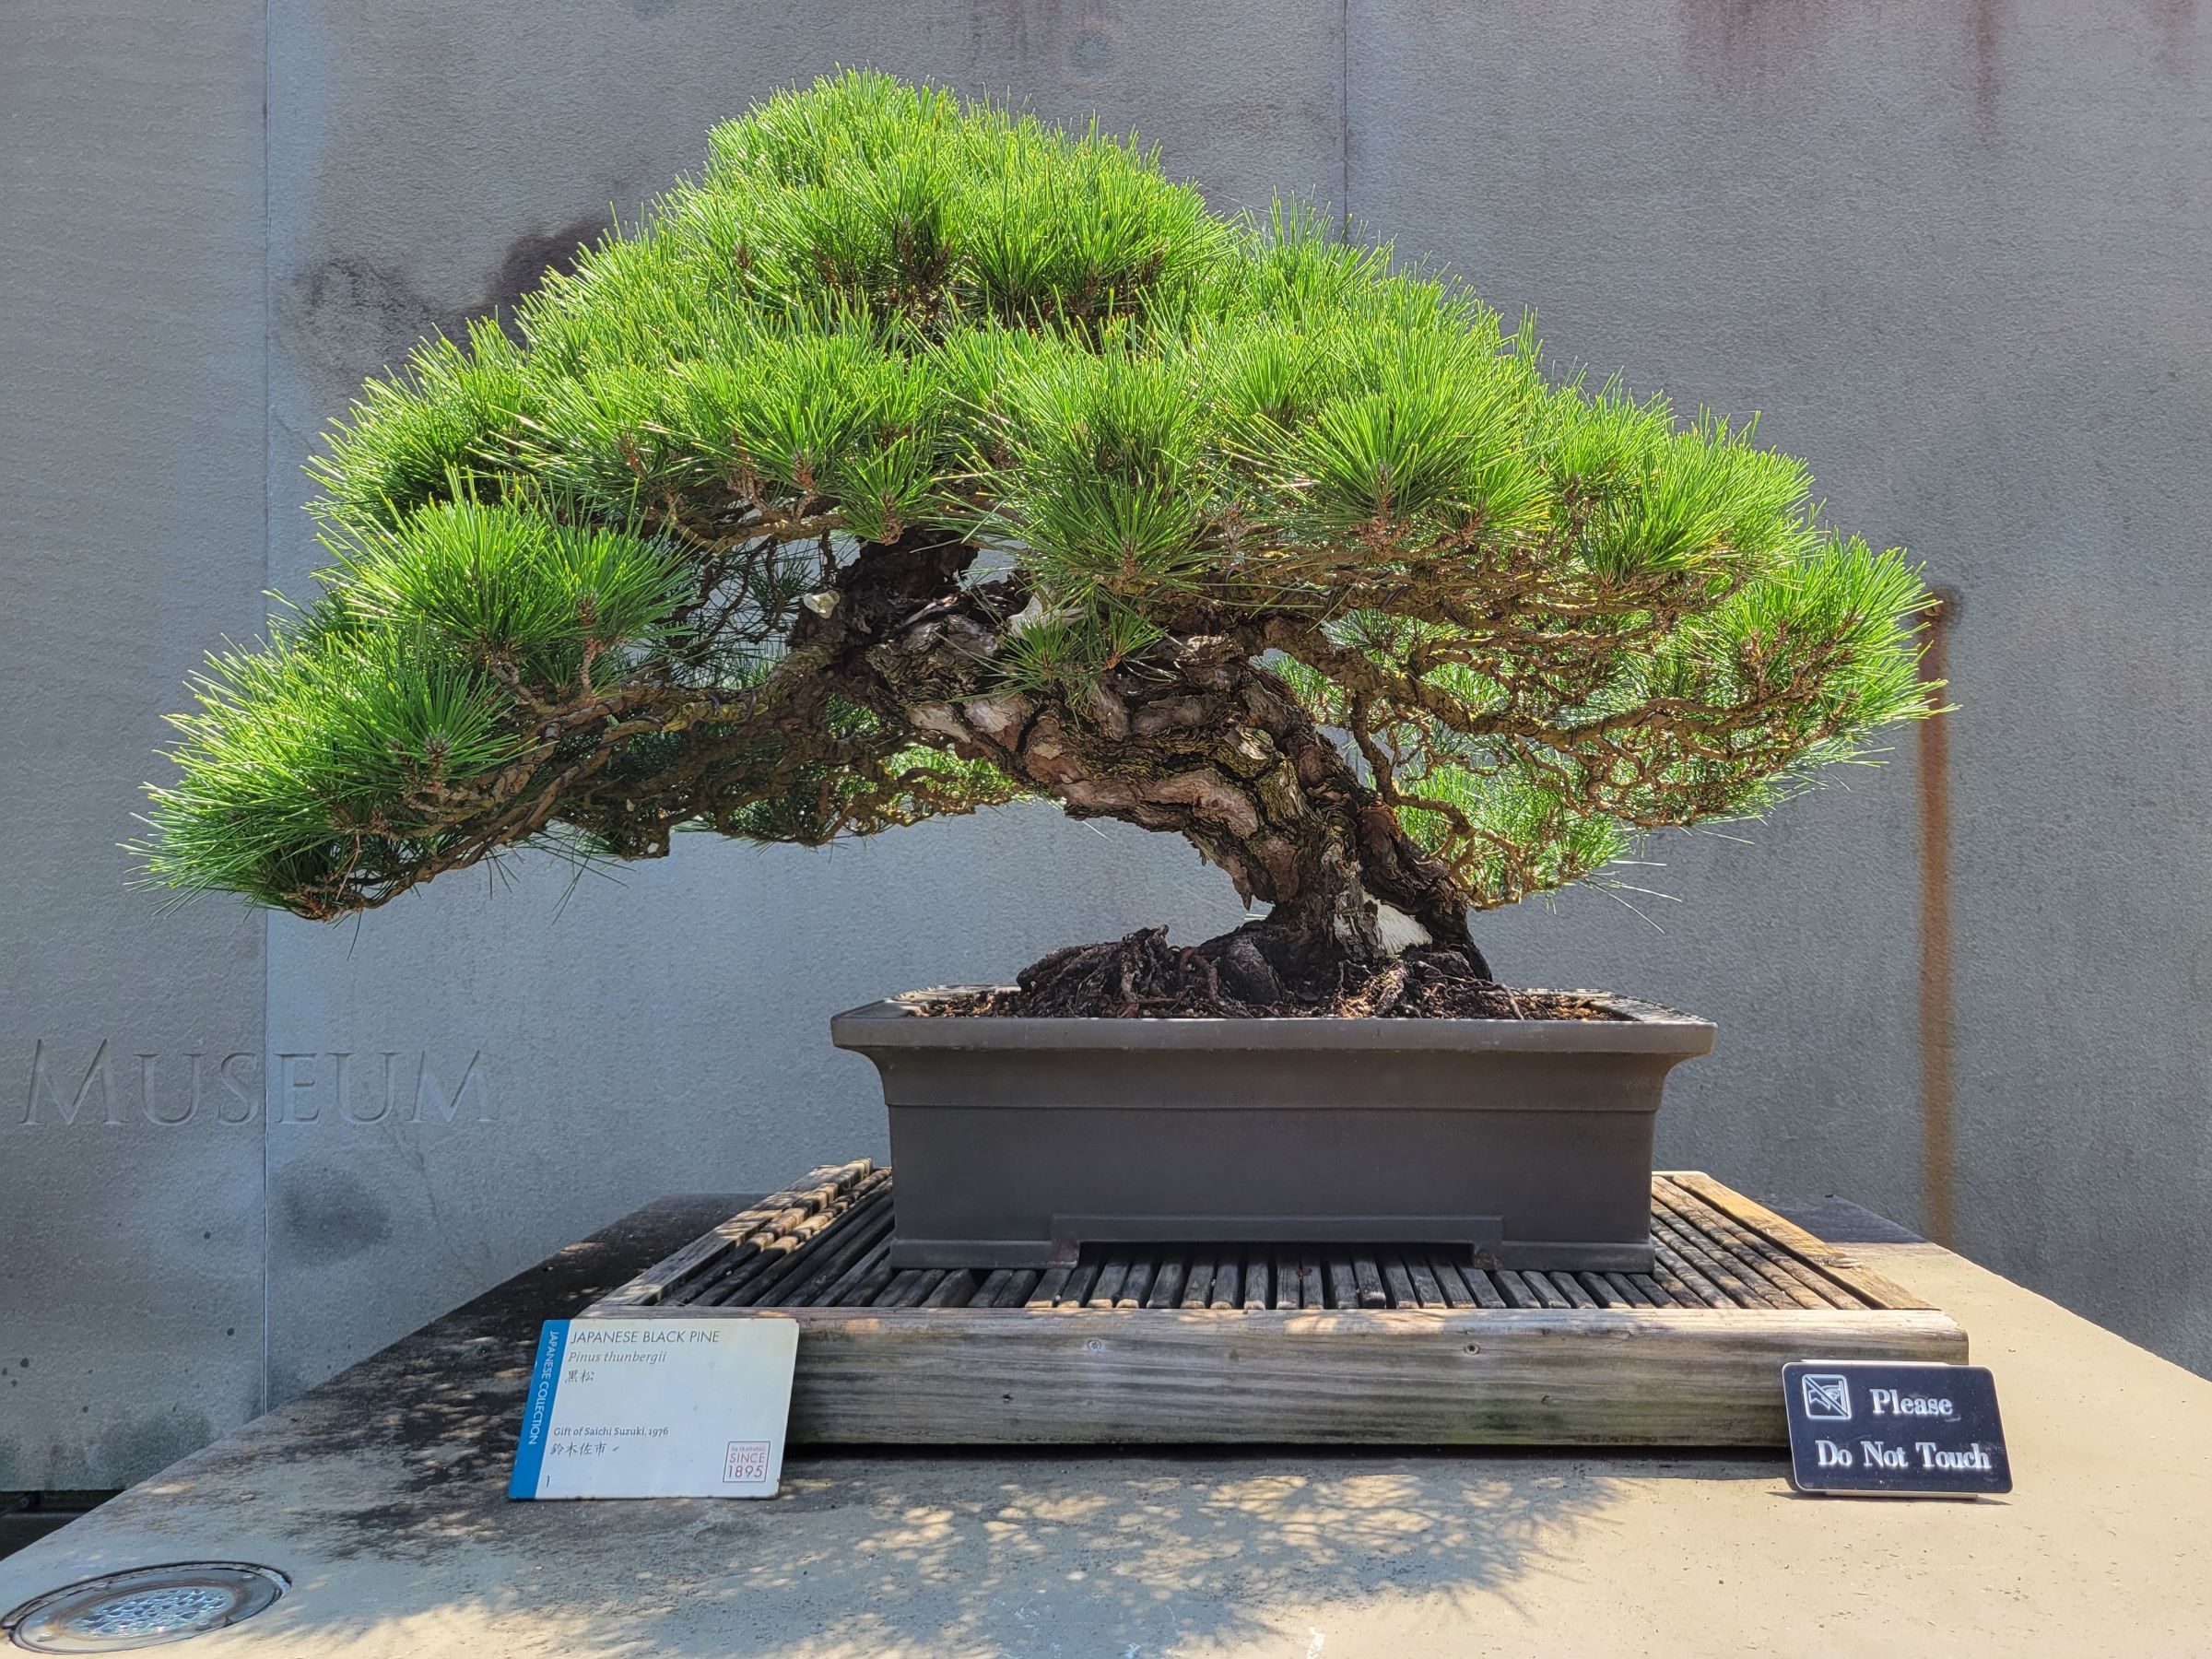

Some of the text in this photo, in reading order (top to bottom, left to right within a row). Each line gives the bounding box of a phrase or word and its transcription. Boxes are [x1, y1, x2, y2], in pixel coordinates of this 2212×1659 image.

[18, 1038, 500, 1126] MUSEUM
[571, 1331, 721, 1344] JAPANESE BLACK PINE
[568, 1351, 667, 1364] Pinus thunbergii
[528, 1330, 559, 1445] JAPANESE COLLECTION
[1869, 1388, 1953, 1415] Please
[554, 1427, 668, 1438] Gift of Saichi Suzuki, 1976
[730, 1453, 765, 1463] SINCE
[1815, 1440, 1992, 1468] Do Not Touch
[729, 1465, 763, 1477] 1895
